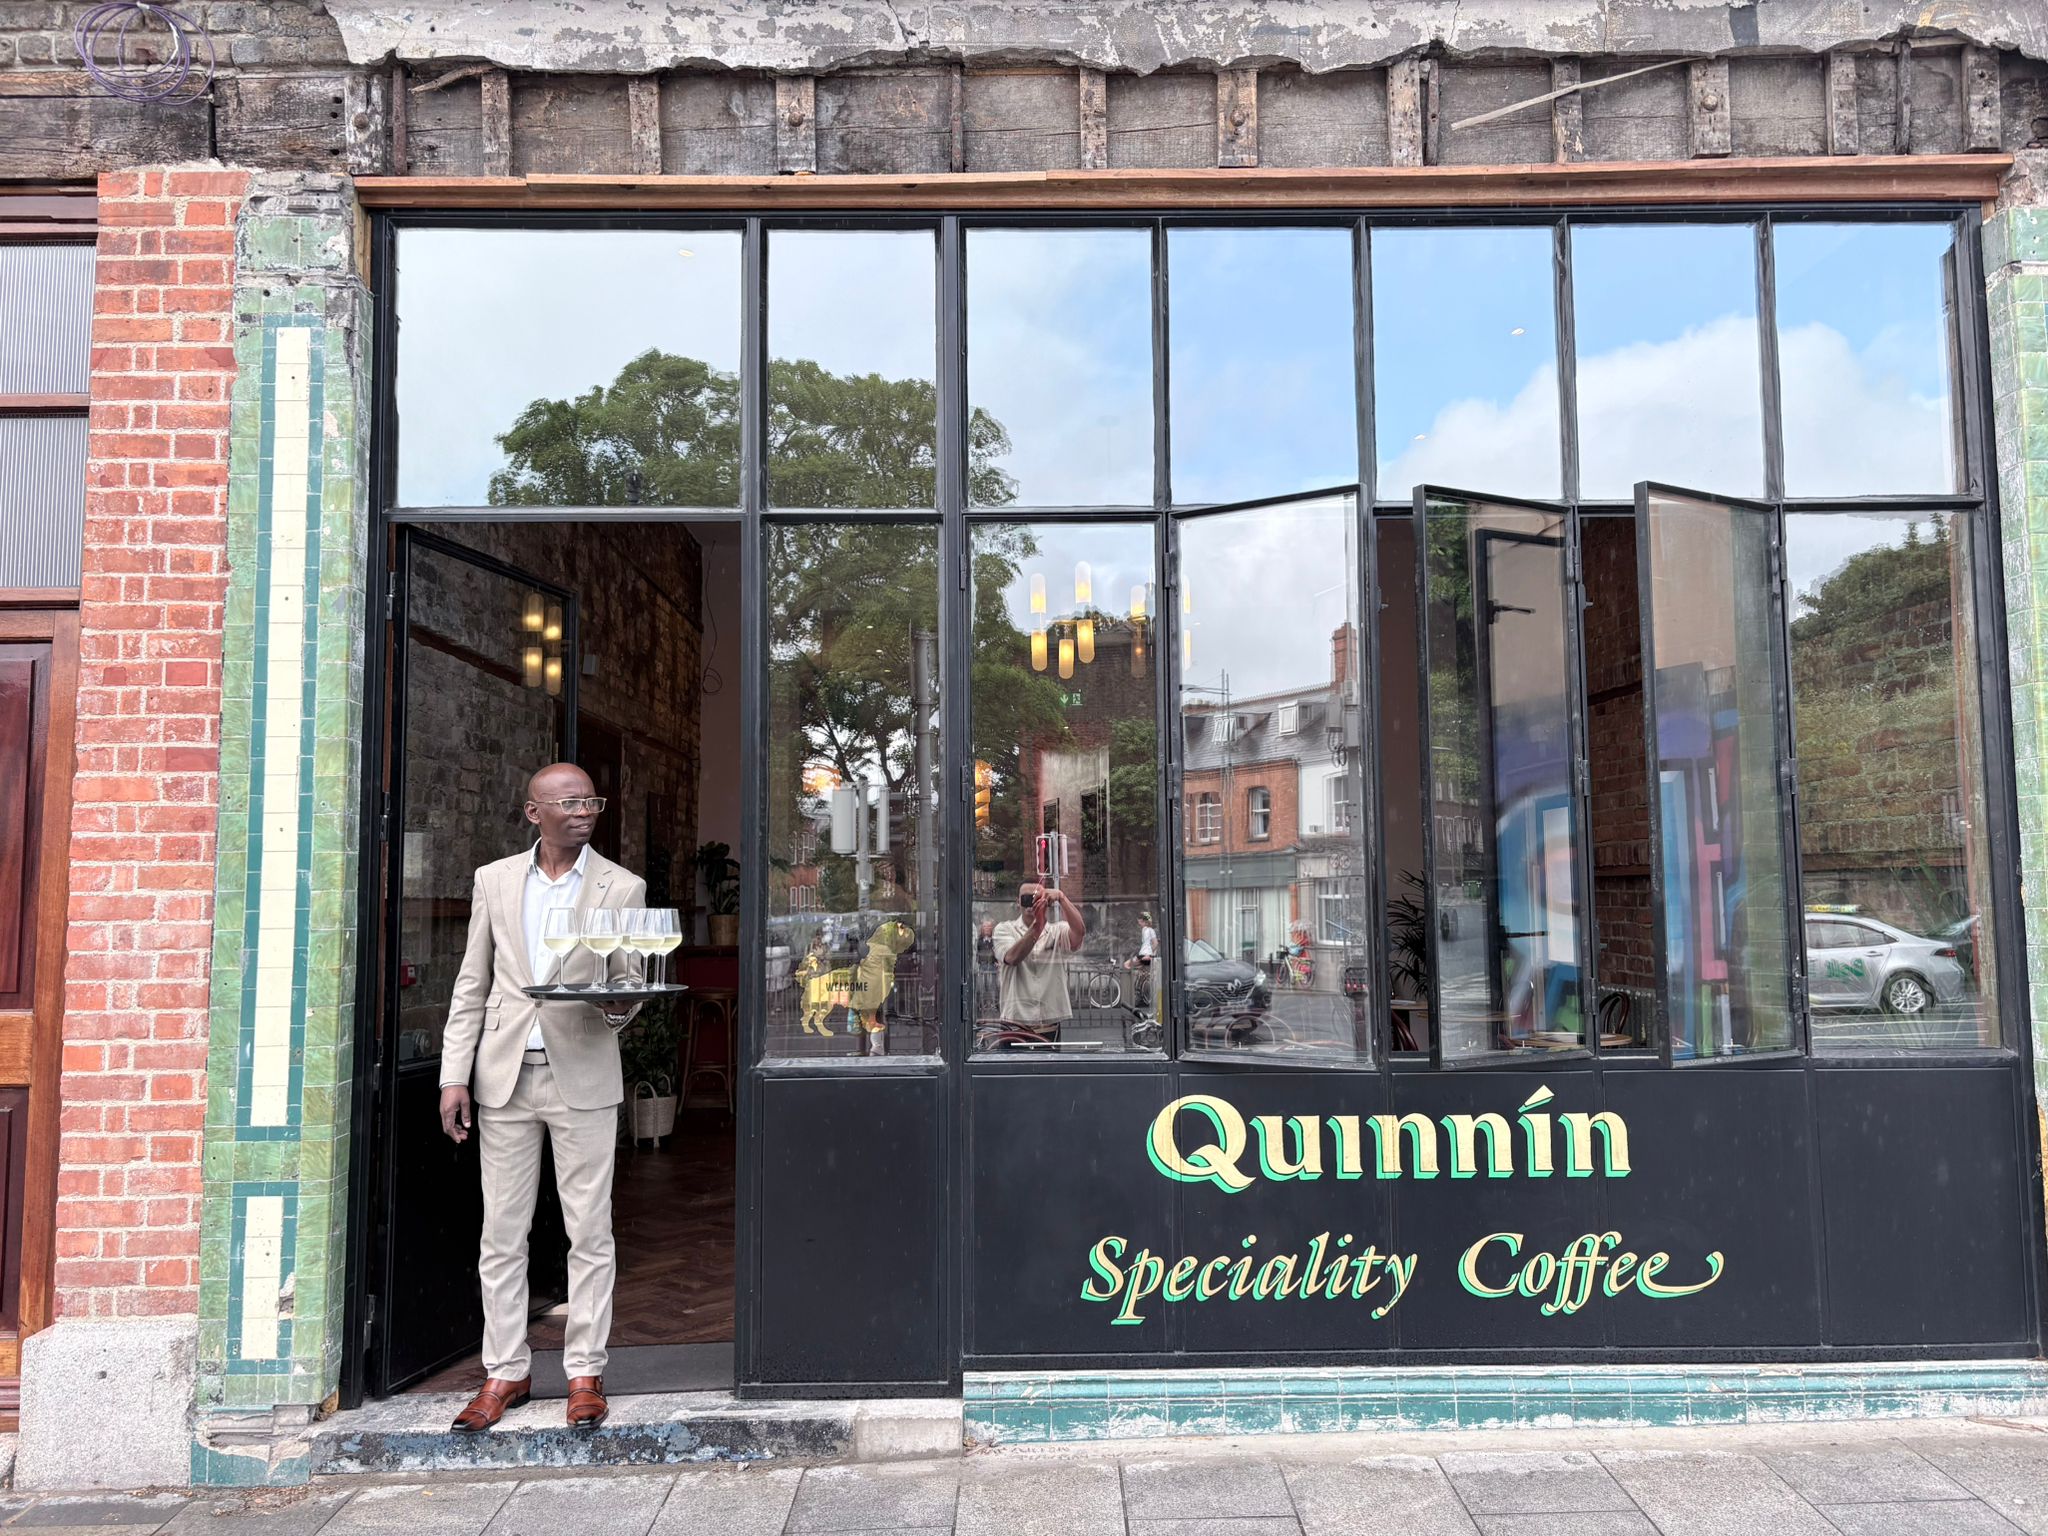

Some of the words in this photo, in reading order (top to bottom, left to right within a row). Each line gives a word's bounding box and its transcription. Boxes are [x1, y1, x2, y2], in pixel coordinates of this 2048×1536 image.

[826, 982, 868, 992] WELCOME
[1081, 1231, 1418, 1325] Speciality
[1458, 1231, 1725, 1316] Coffee
